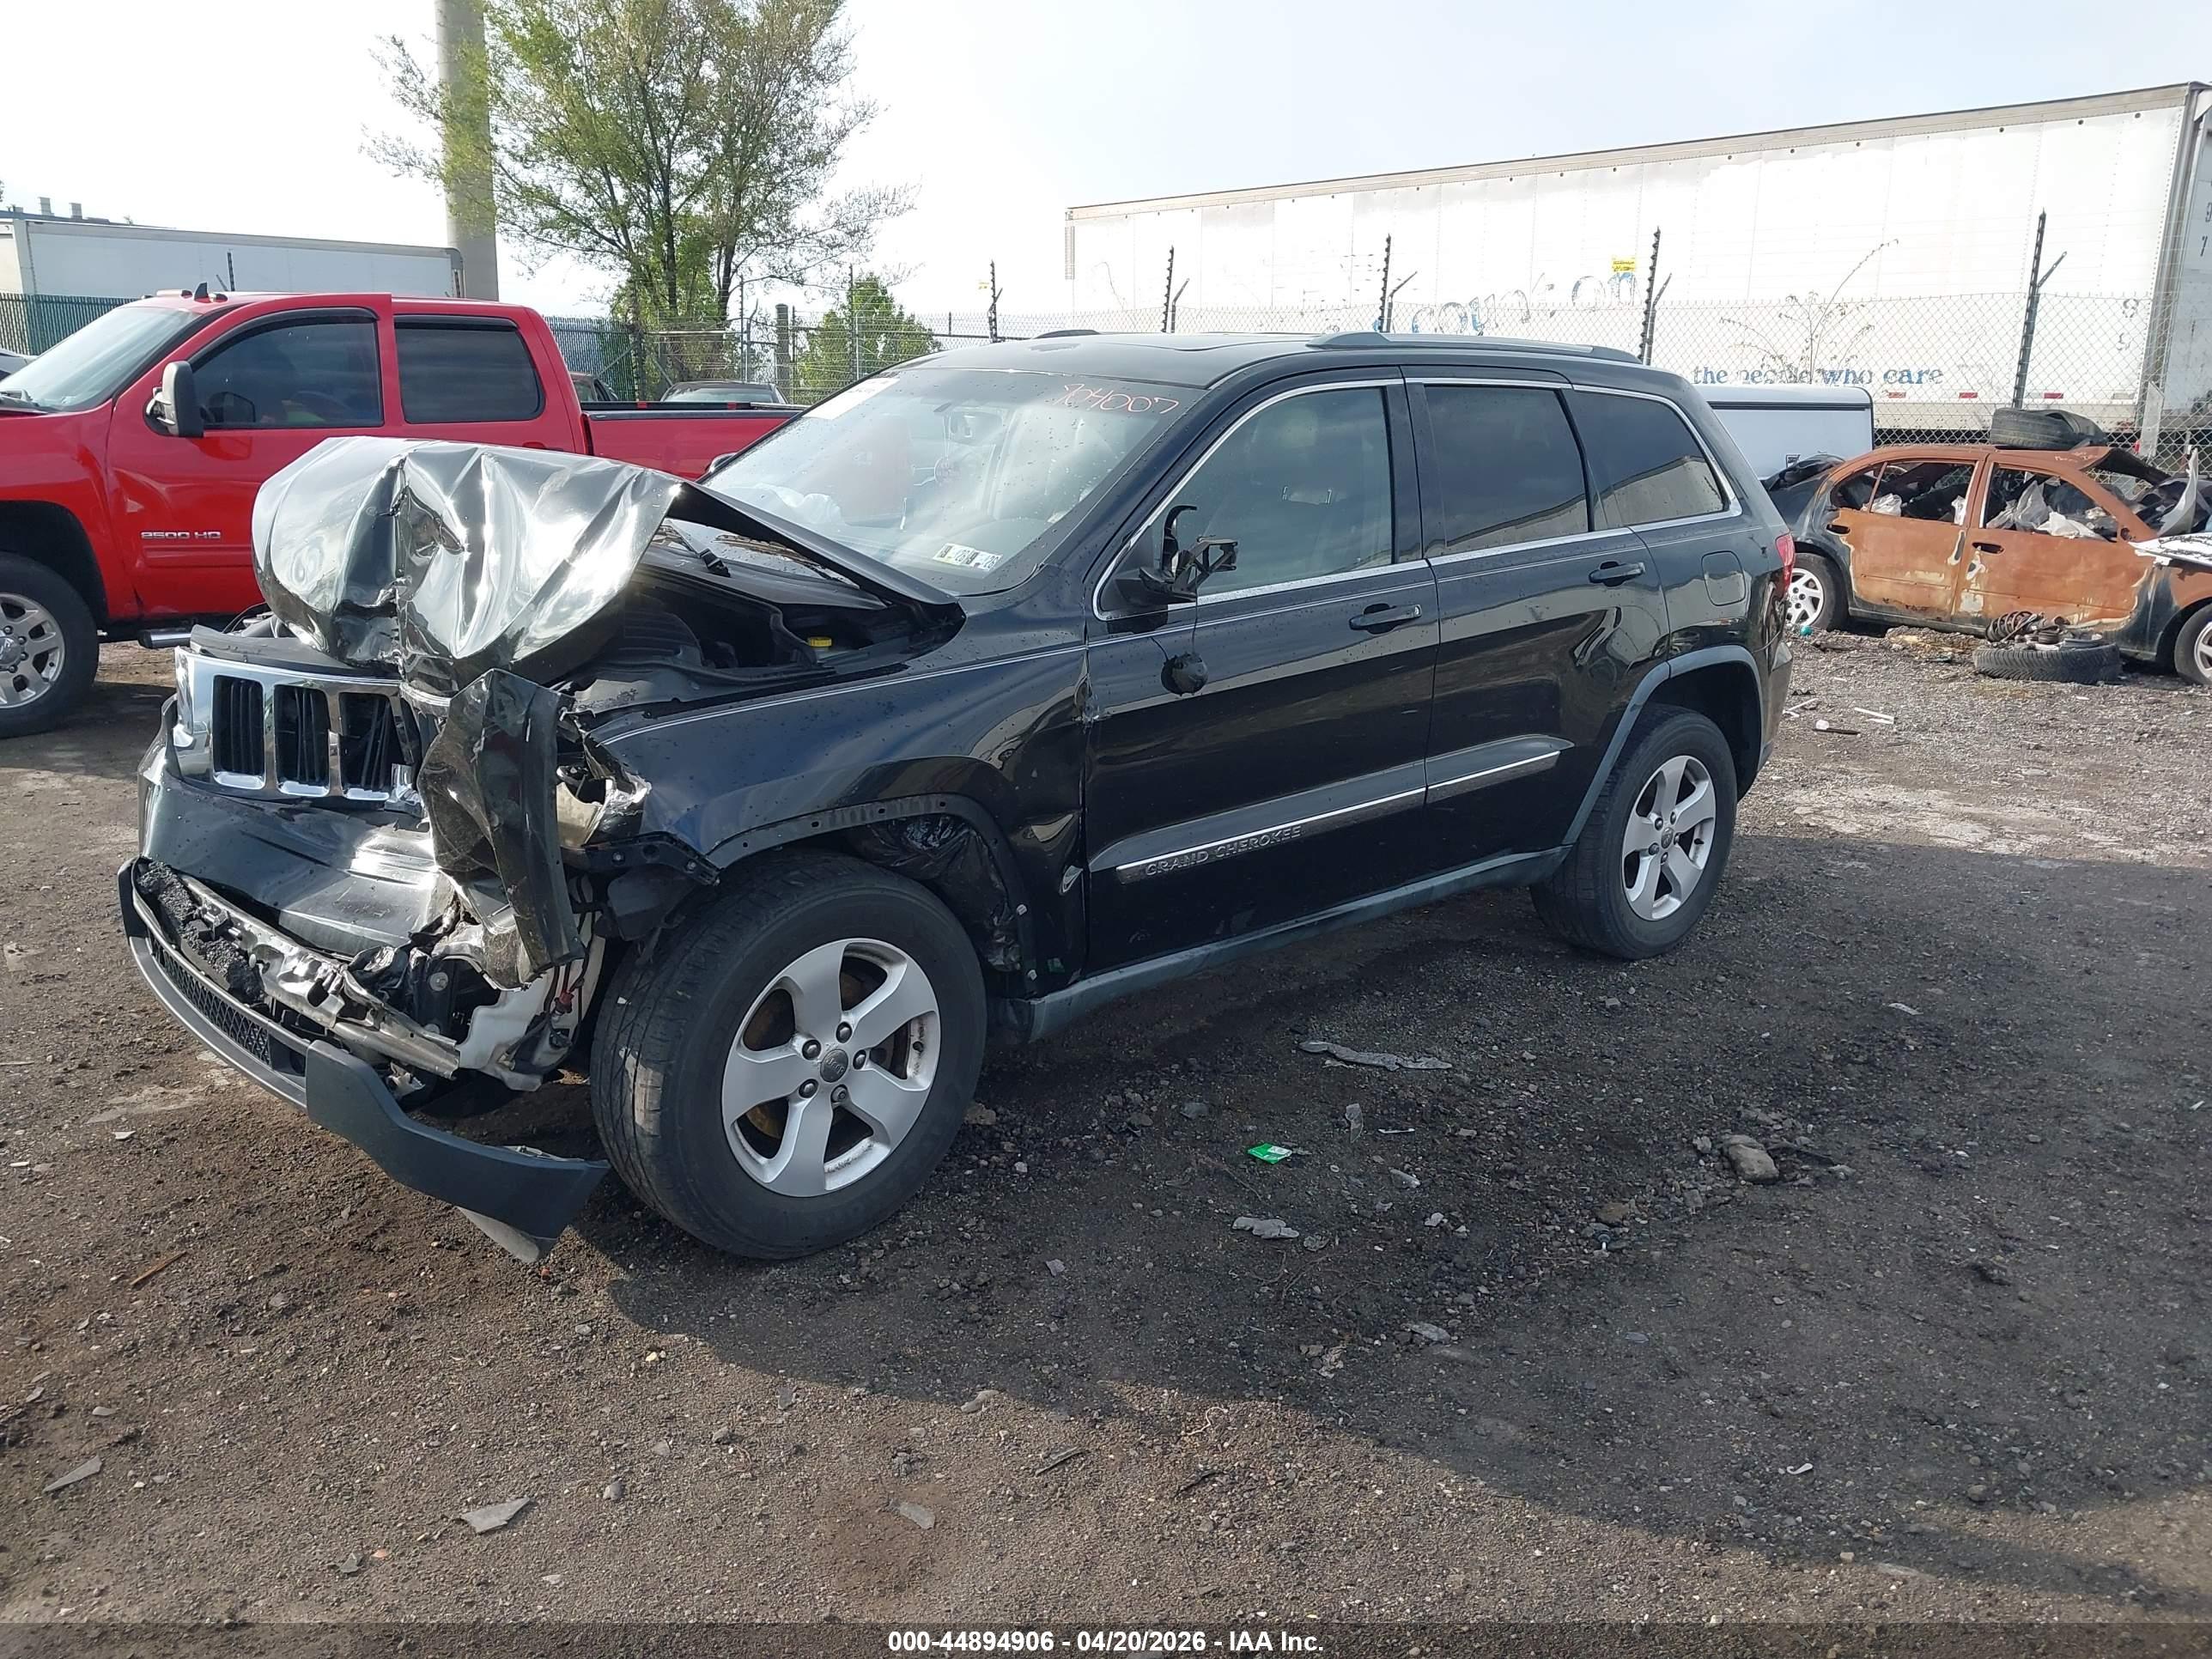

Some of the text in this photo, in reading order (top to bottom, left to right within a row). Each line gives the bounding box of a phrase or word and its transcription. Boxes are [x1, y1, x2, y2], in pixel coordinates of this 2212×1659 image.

[1692, 366, 1729, 384] the
[1820, 368, 1873, 385] who
[1882, 368, 1943, 385] care
[194, 531, 222, 540] HD
[1146, 825, 1303, 875] GRAND CHEROKEE
